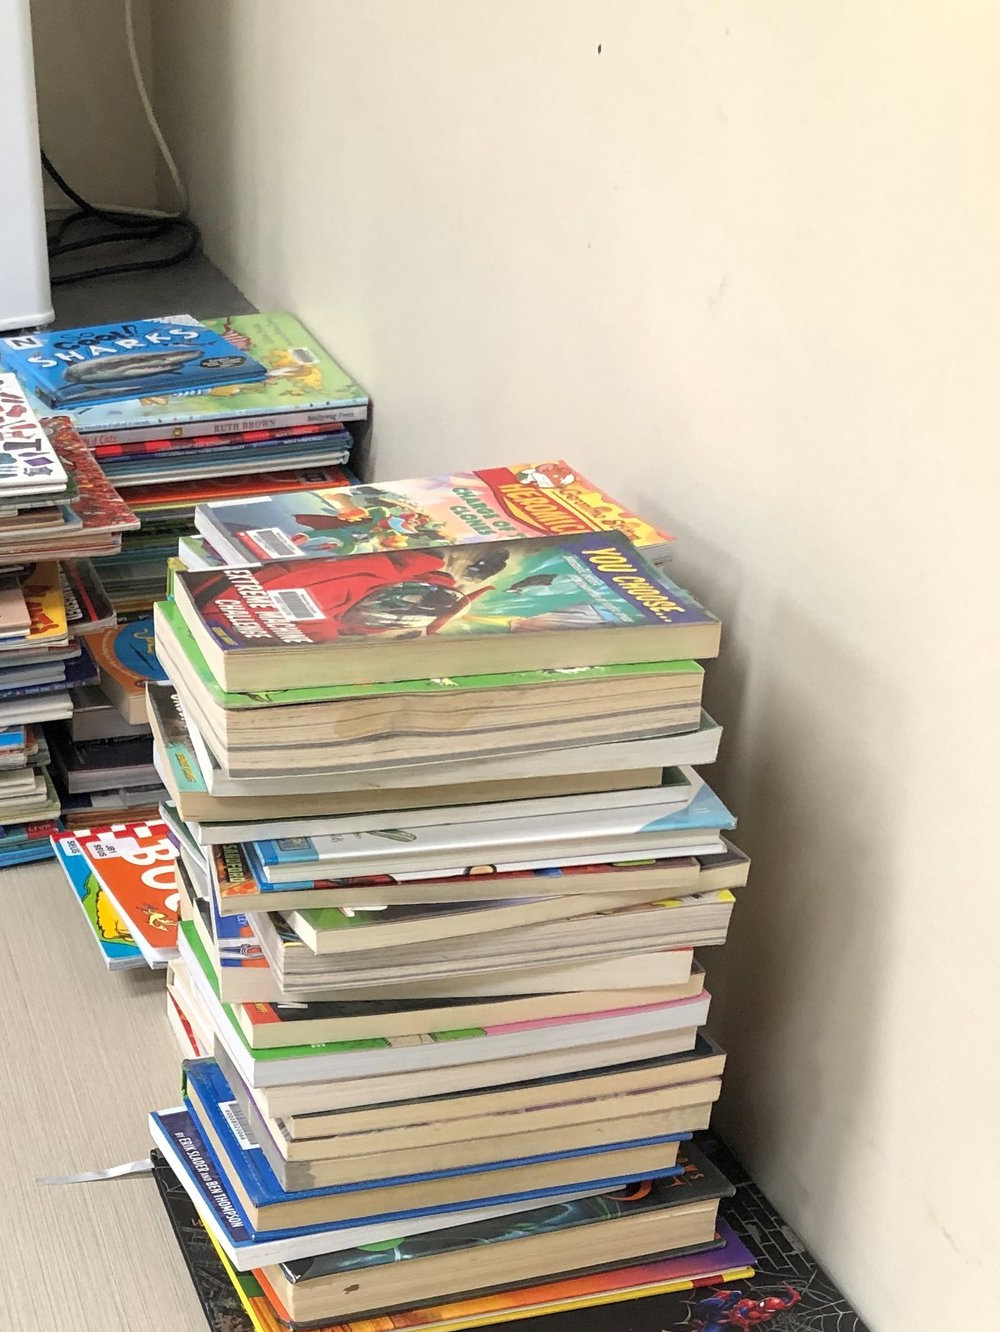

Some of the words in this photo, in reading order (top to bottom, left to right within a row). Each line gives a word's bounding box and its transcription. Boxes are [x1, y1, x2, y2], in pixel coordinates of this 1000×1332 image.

[27, 328, 199, 368] SHARKS
[213, 423, 240, 433] RUTH
[242, 418, 276, 430] BROWN
[581, 546, 639, 574] YOU
[223, 569, 274, 611] EXTREME
[255, 609, 315, 644] MACHINE
[178, 1137, 197, 1152] ERIK
[187, 1150, 210, 1173] SLADER
[206, 1180, 223, 1195] BEN
[212, 1193, 244, 1228] THOMPSON
